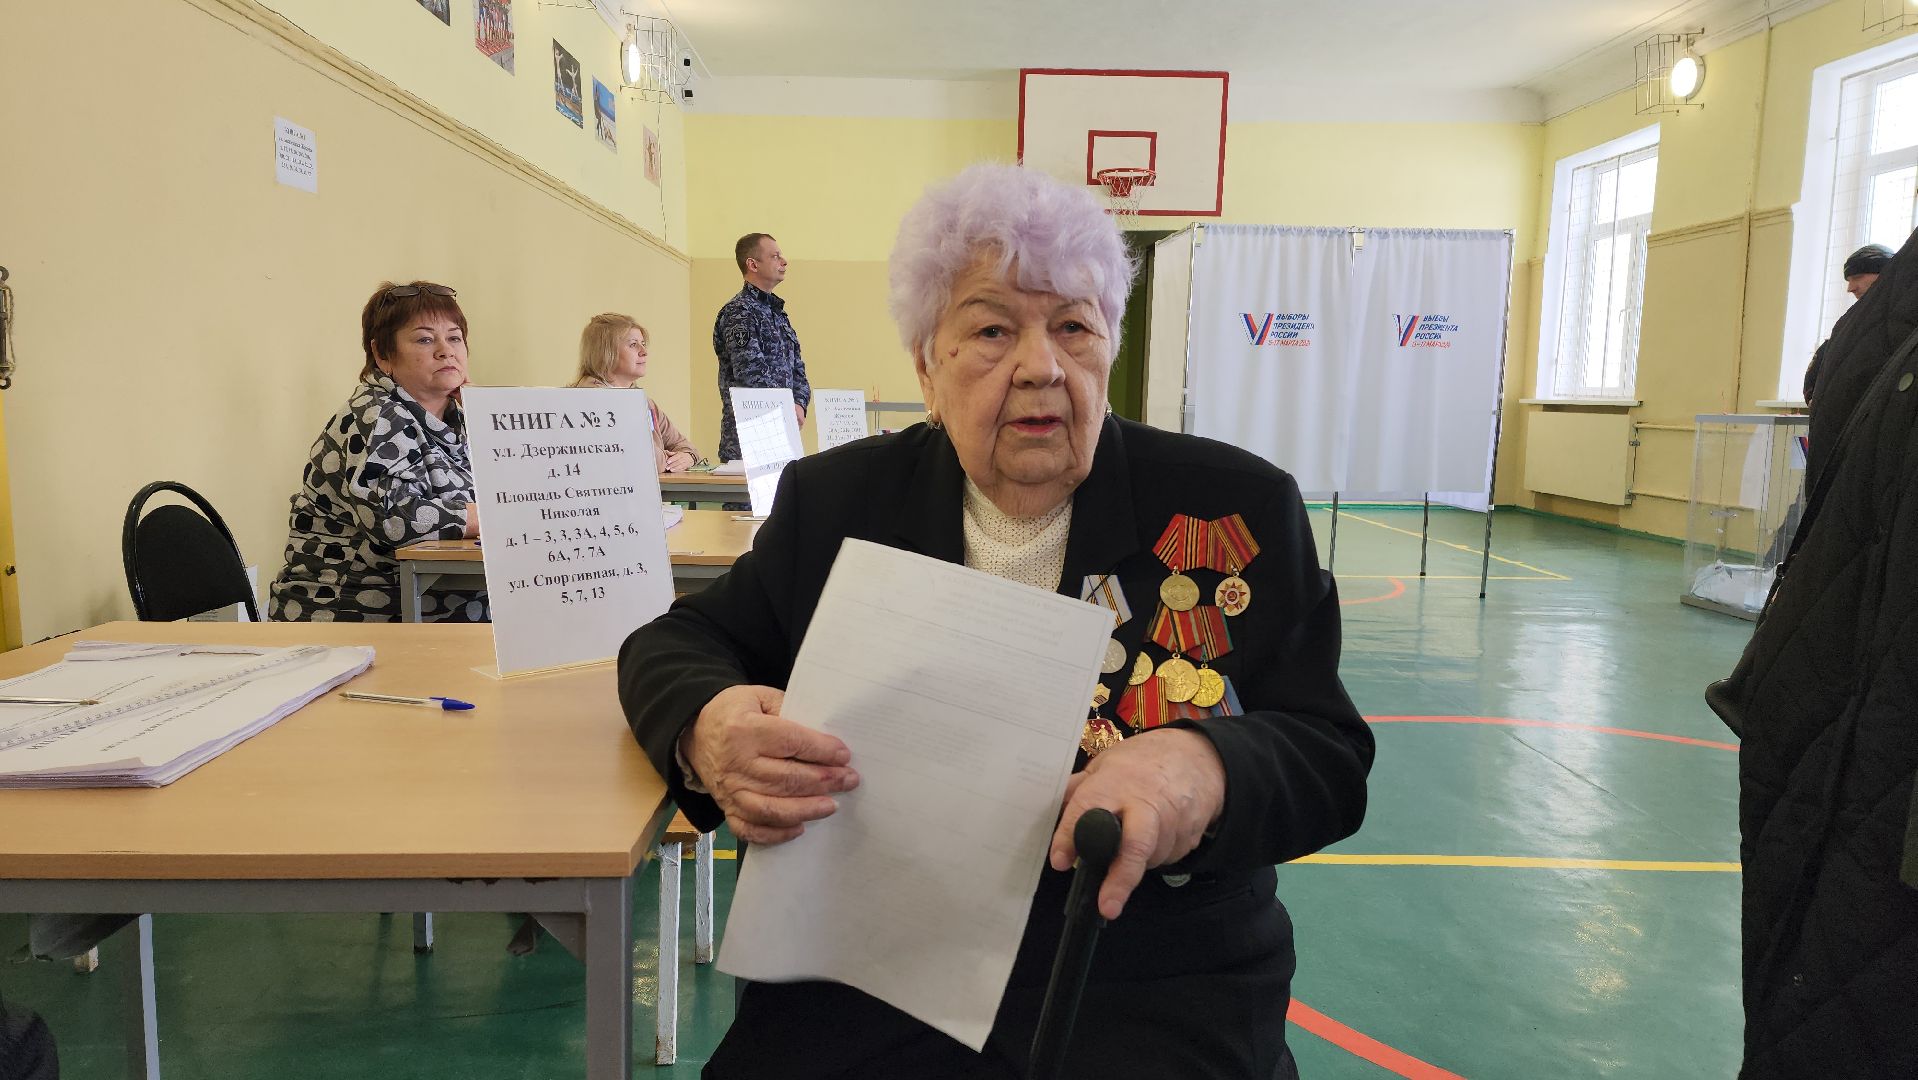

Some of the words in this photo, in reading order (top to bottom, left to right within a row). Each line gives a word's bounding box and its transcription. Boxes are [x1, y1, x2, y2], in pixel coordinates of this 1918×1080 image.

[491, 412, 575, 431] КНИГА
[580, 411, 601, 429] №
[606, 411, 616, 428] 3
[492, 447, 516, 462] ул.
[520, 443, 625, 459] Дзержинская,
[547, 468, 561, 479] д.
[565, 462, 581, 476] 14
[496, 490, 562, 505] Площадь
[565, 485, 634, 499] Святителя
[540, 506, 600, 520] Николая
[506, 537, 518, 547] д.
[523, 532, 529, 545] 1
[545, 531, 557, 544] 3,
[560, 529, 572, 542] 3,
[575, 528, 597, 539] 3А,
[600, 526, 611, 537] 4,
[613, 524, 625, 536] 5,
[628, 523, 639, 536] 6,
[548, 550, 571, 563] 6А,
[588, 546, 606, 558] 7А
[508, 580, 529, 593] ул.
[623, 566, 634, 577] д.
[637, 562, 648, 574] 3,
[561, 591, 573, 605] 5,
[592, 586, 606, 600] 13
